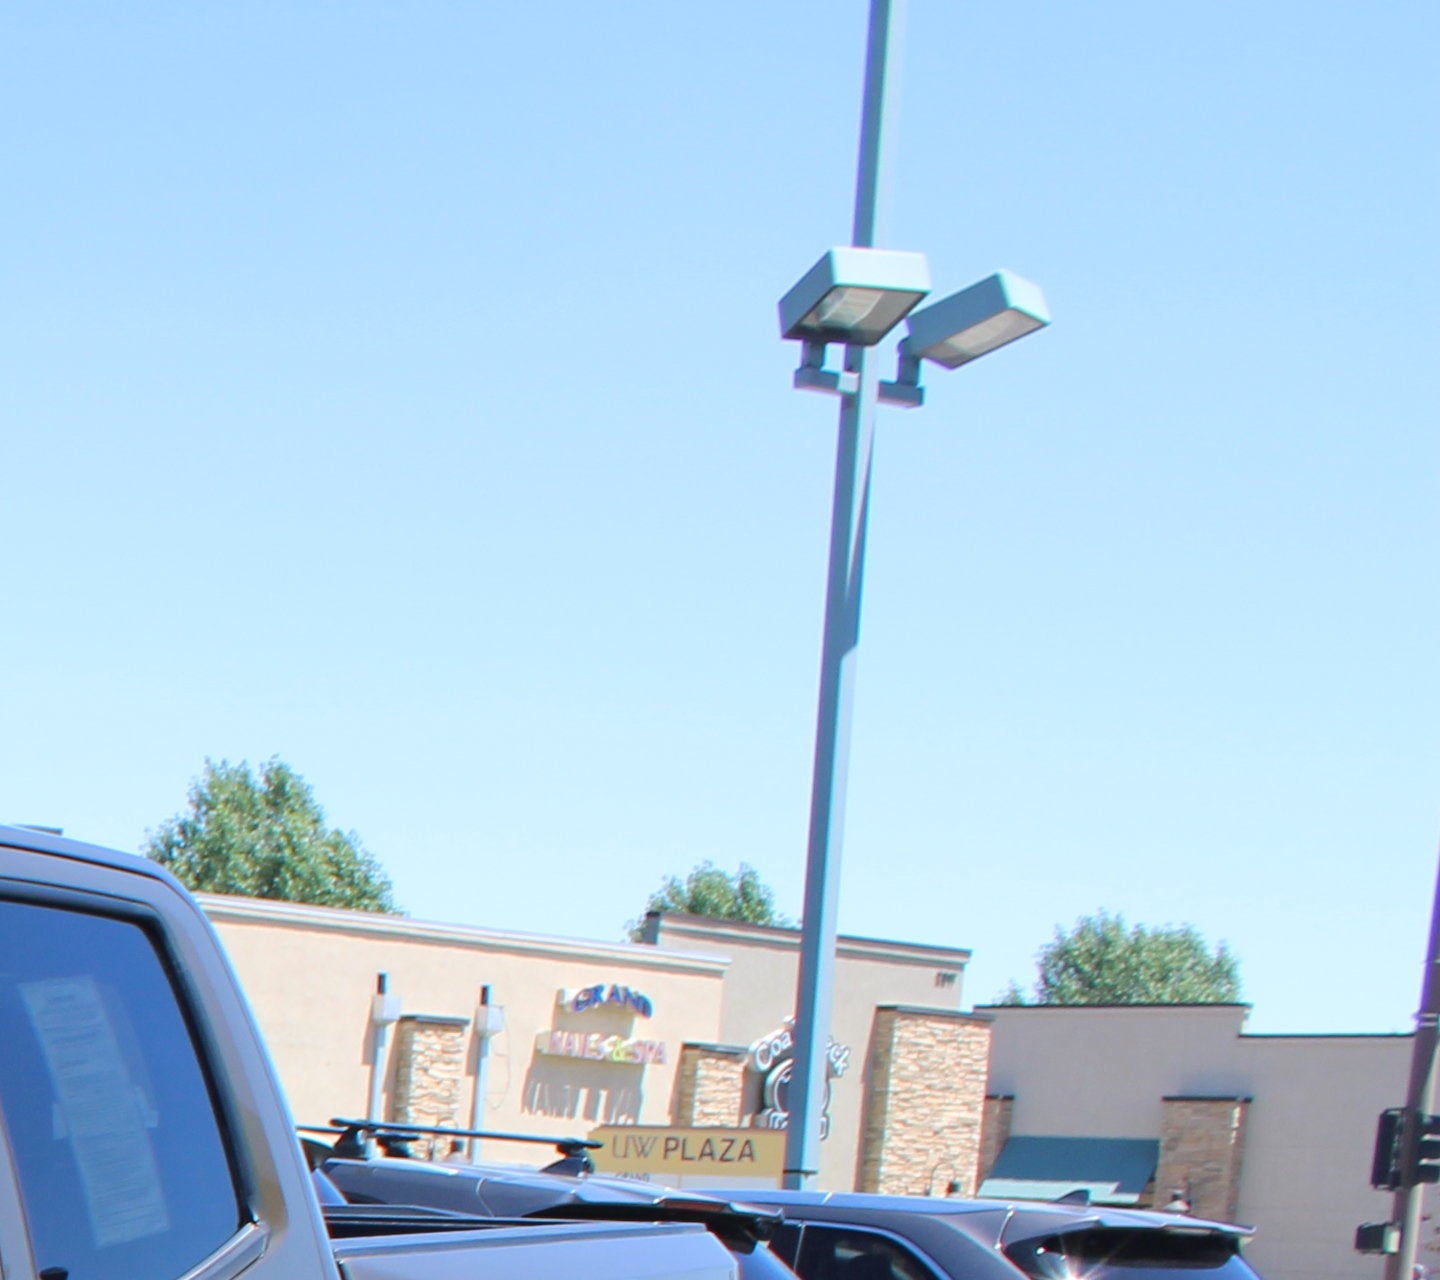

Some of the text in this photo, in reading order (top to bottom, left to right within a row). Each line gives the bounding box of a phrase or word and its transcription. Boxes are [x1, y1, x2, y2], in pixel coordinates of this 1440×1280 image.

[573, 983, 654, 1019] GRAND
[612, 1134, 757, 1163] UW PLAZA
